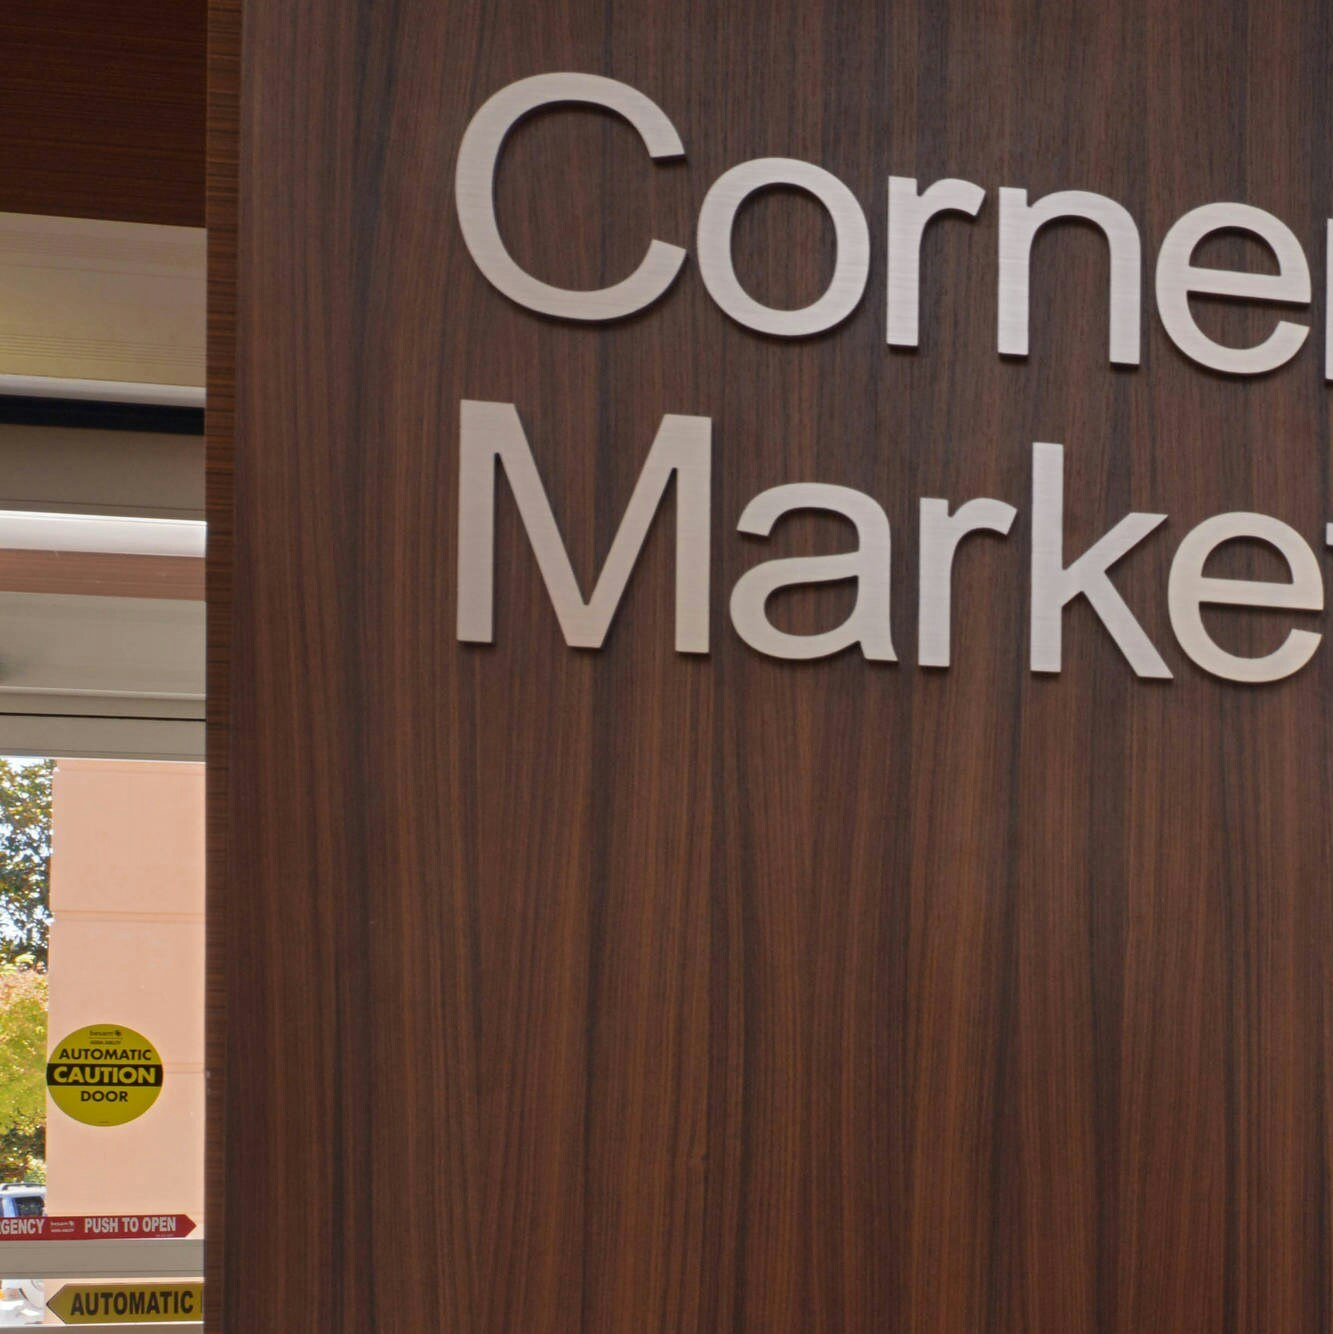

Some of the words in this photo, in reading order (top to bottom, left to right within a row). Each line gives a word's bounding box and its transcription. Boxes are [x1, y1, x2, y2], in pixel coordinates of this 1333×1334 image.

[59, 1048, 151, 1060] AUTOMATIC
[53, 1066, 156, 1083] CAUTION
[81, 1090, 128, 1102] DOOR
[0, 1218, 45, 1234] GENCY
[84, 1217, 118, 1233] PUSH
[122, 1217, 139, 1232] TO
[142, 1216, 176, 1232] OPEN
[70, 1290, 194, 1316] AUTOMATIC
